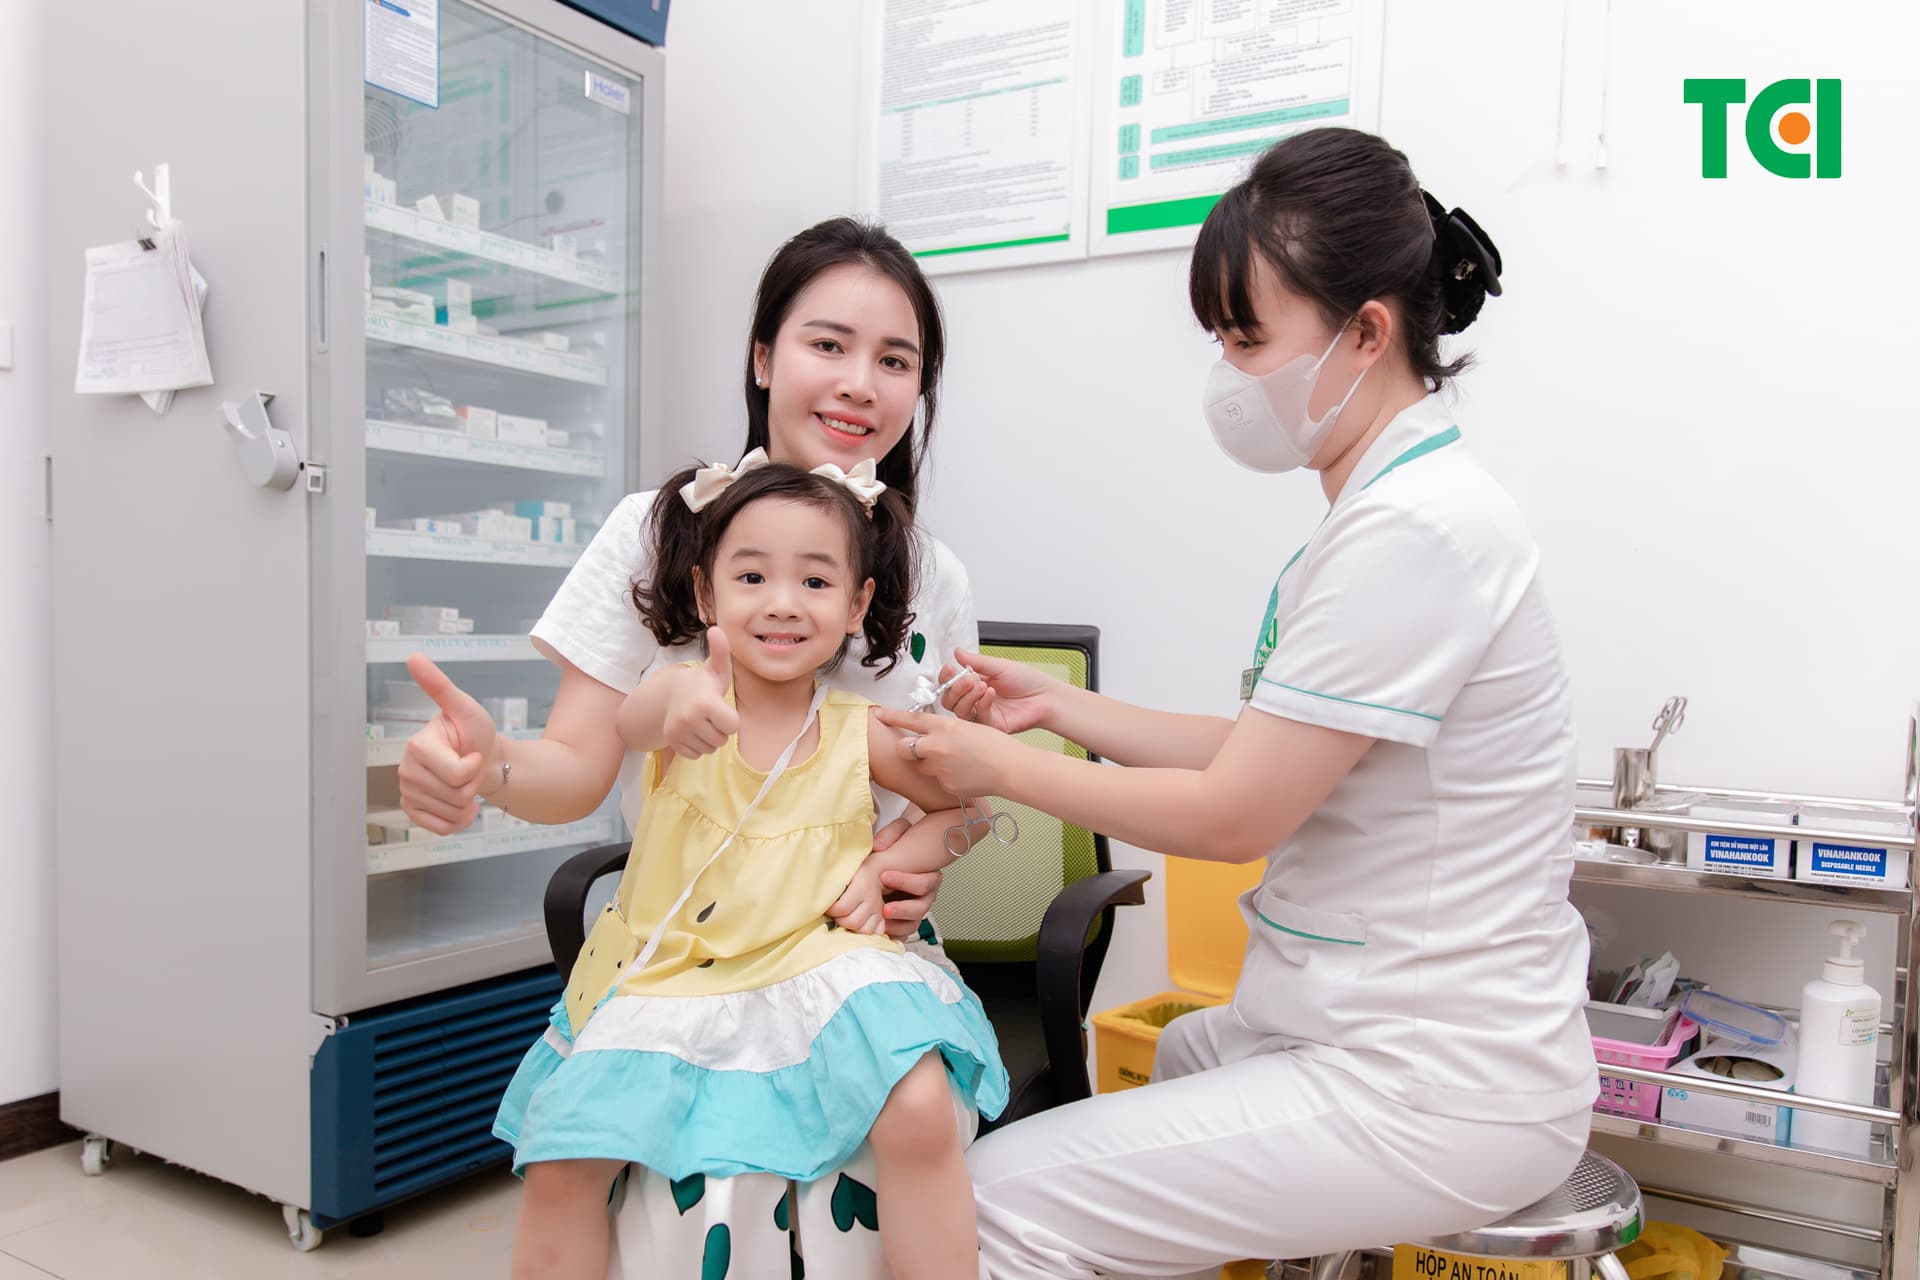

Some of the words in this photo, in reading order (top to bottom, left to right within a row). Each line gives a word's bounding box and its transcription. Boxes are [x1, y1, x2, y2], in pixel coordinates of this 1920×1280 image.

[593, 78, 624, 102] Haier
[1710, 849, 1769, 863] VINAHANKOOK
[1817, 848, 1881, 863] VINAHANKOOK
[1821, 861, 1854, 871] DISPOSABLE
[1855, 864, 1876, 873] NEEDLE
[1416, 1250, 1446, 1280] HỘP
[1450, 1262, 1472, 1280] AN
